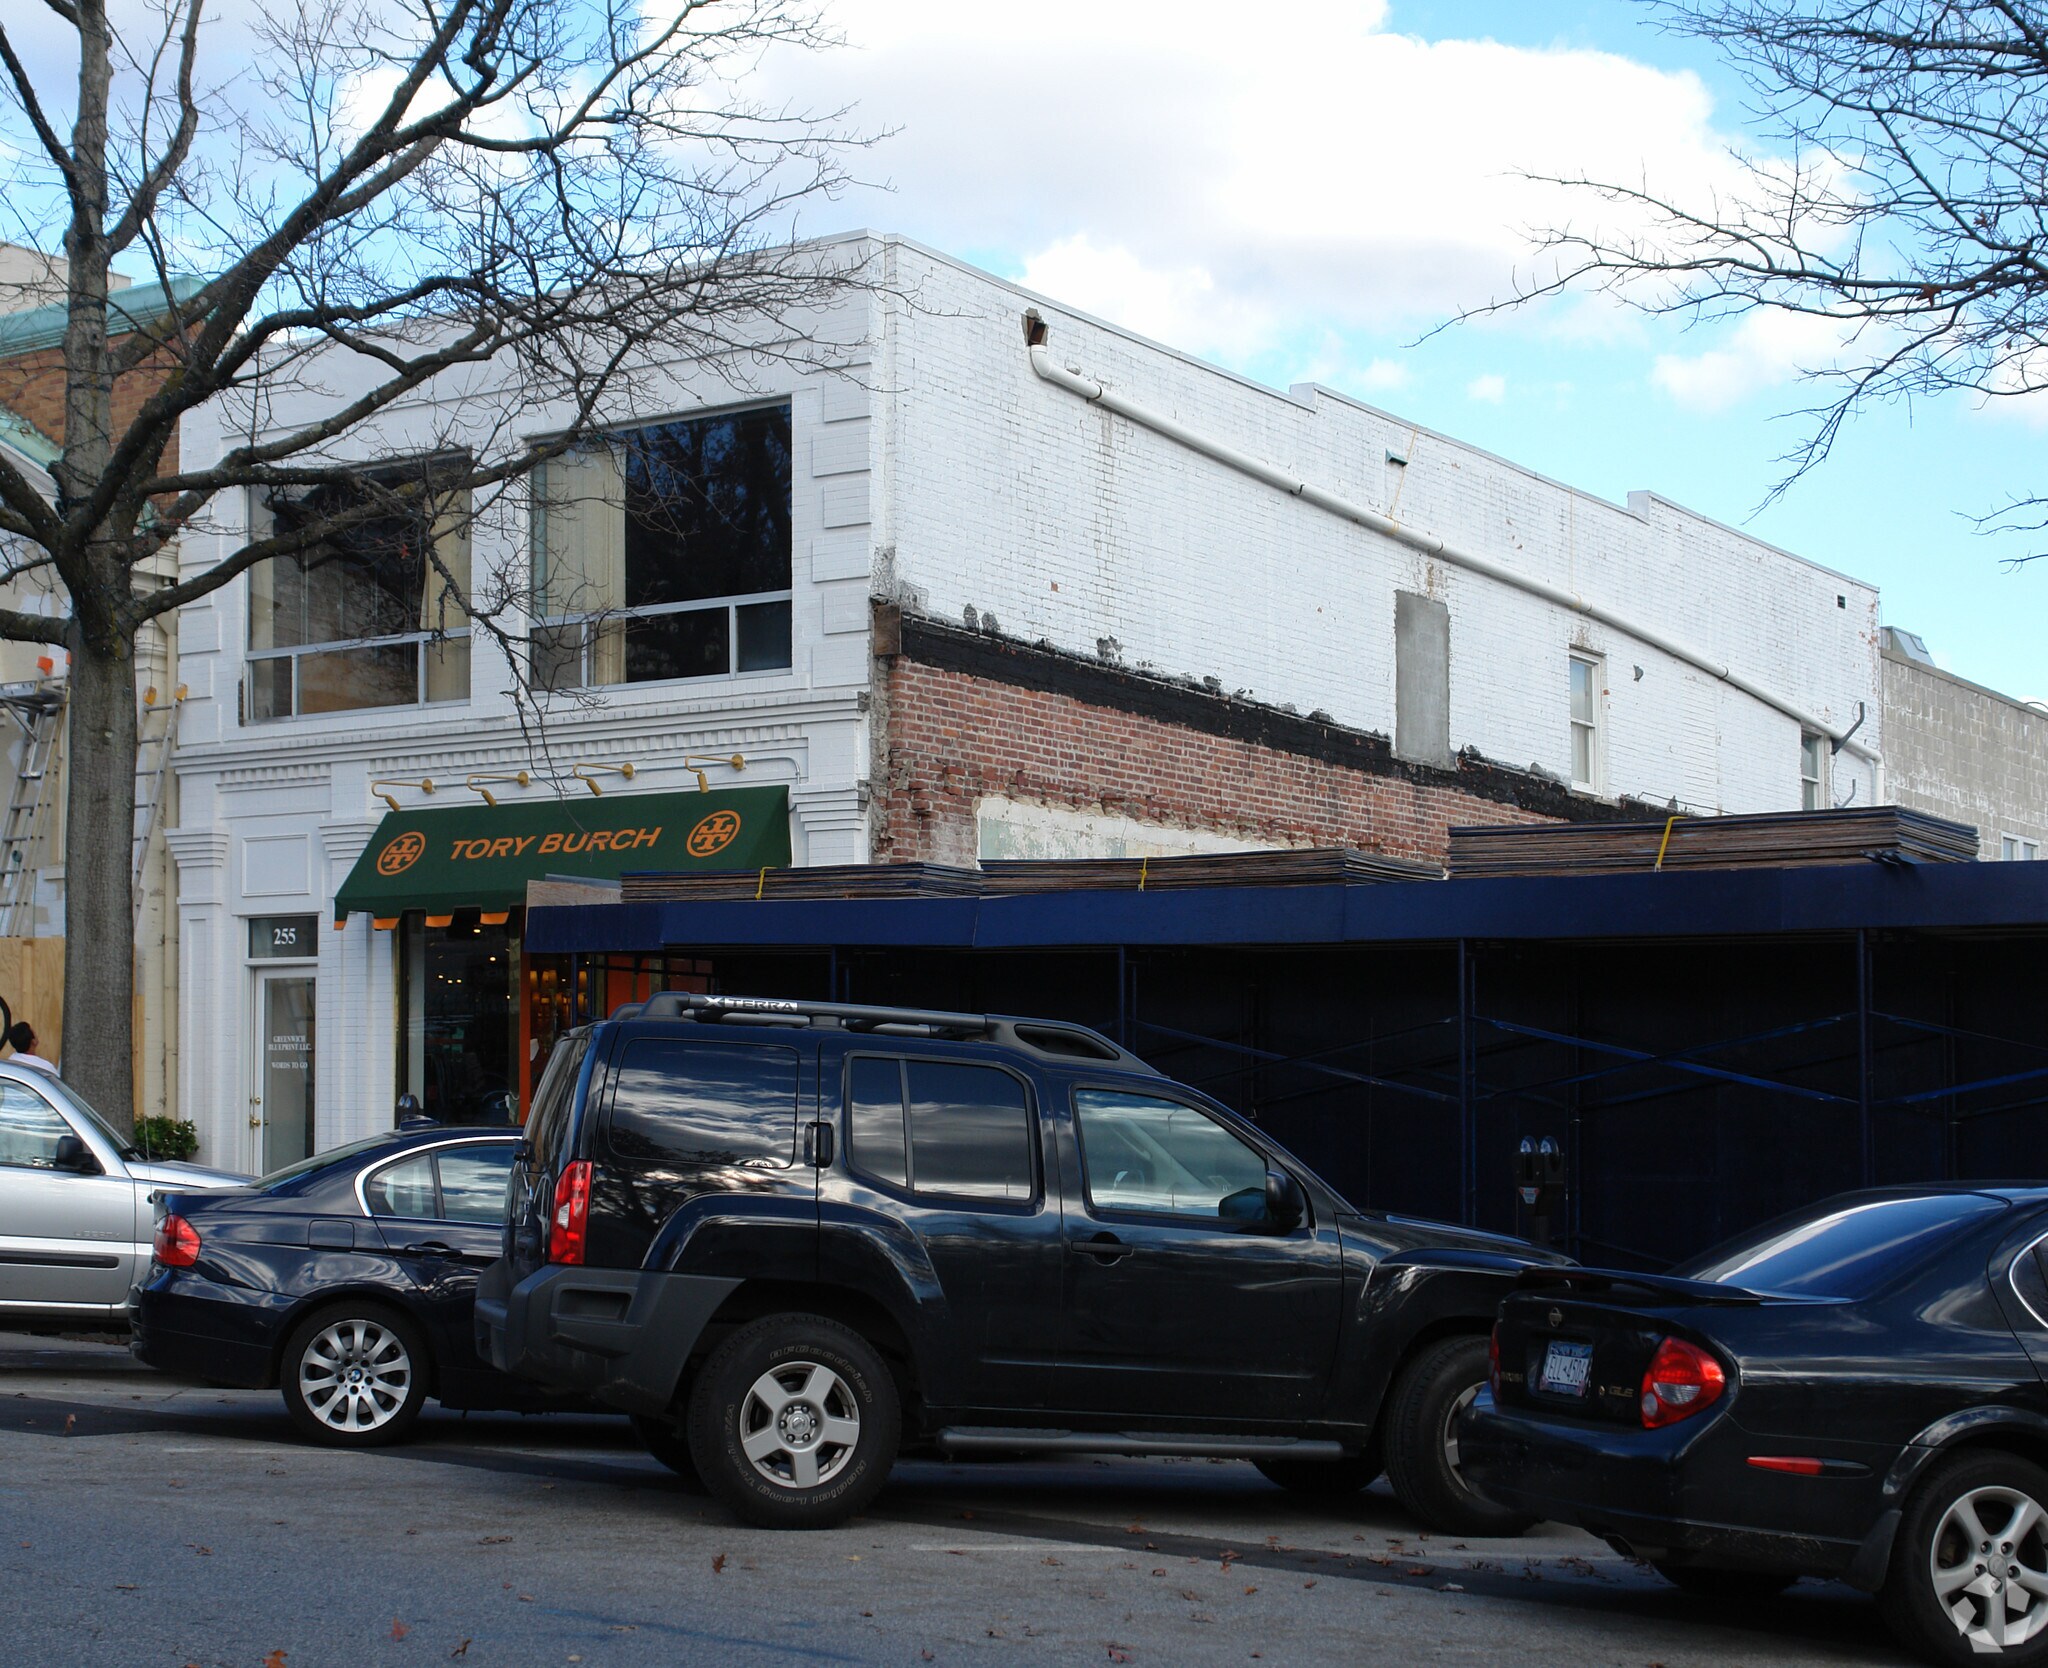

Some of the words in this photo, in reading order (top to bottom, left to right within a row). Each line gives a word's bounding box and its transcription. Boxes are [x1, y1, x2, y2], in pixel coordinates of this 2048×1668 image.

[450, 835, 536, 860] TORY
[537, 827, 662, 854] BURCH
[273, 927, 296, 945] 255
[704, 996, 798, 1012] XTERRA
[273, 1035, 306, 1043] GREENWICH
